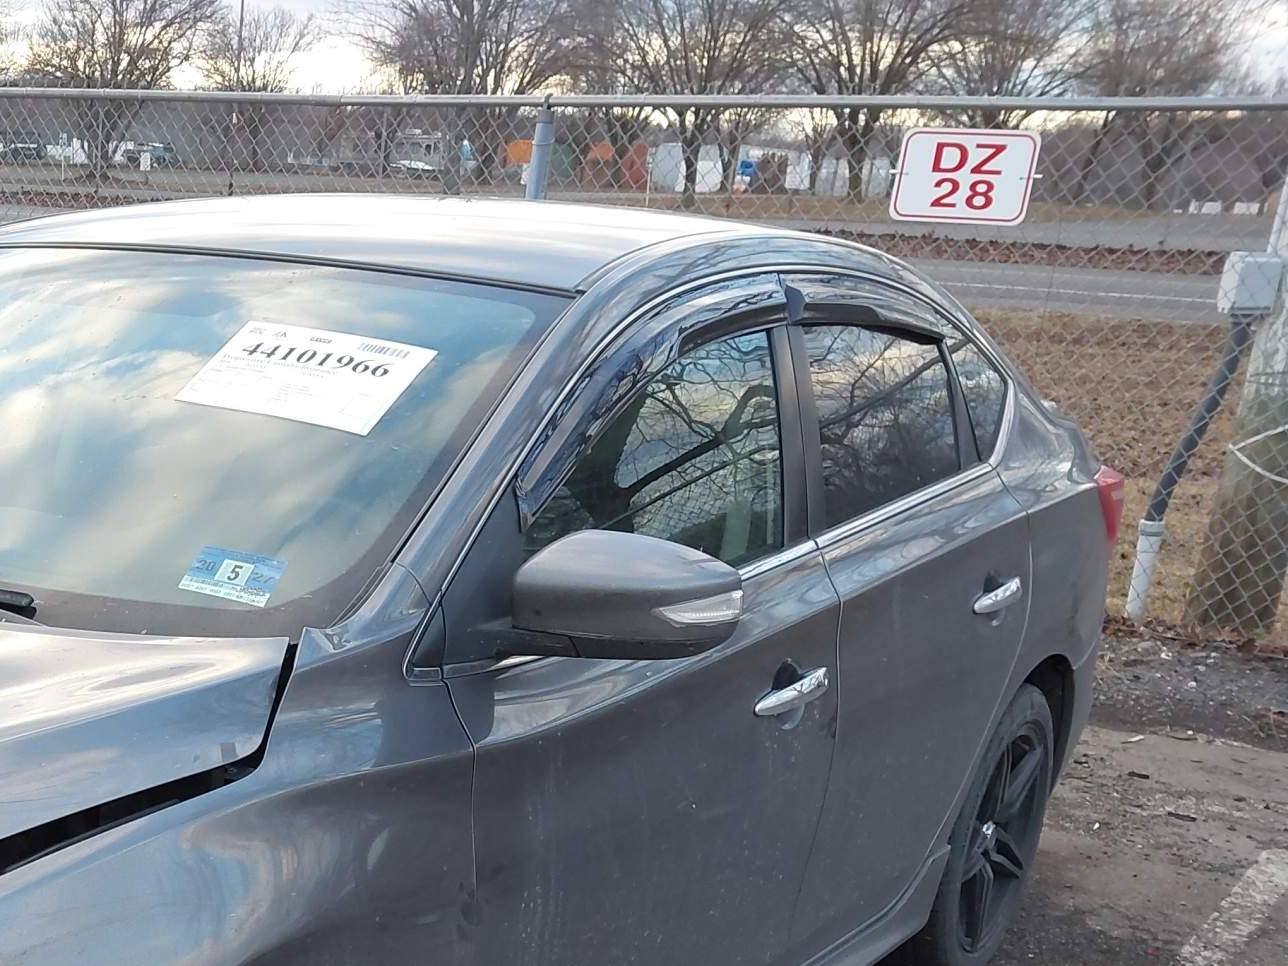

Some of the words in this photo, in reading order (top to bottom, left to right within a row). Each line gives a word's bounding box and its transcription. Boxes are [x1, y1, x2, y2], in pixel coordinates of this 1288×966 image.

[931, 142, 1007, 175] DZ
[929, 177, 994, 210] 28
[241, 341, 396, 378] 44101966
[226, 564, 244, 582] 5
